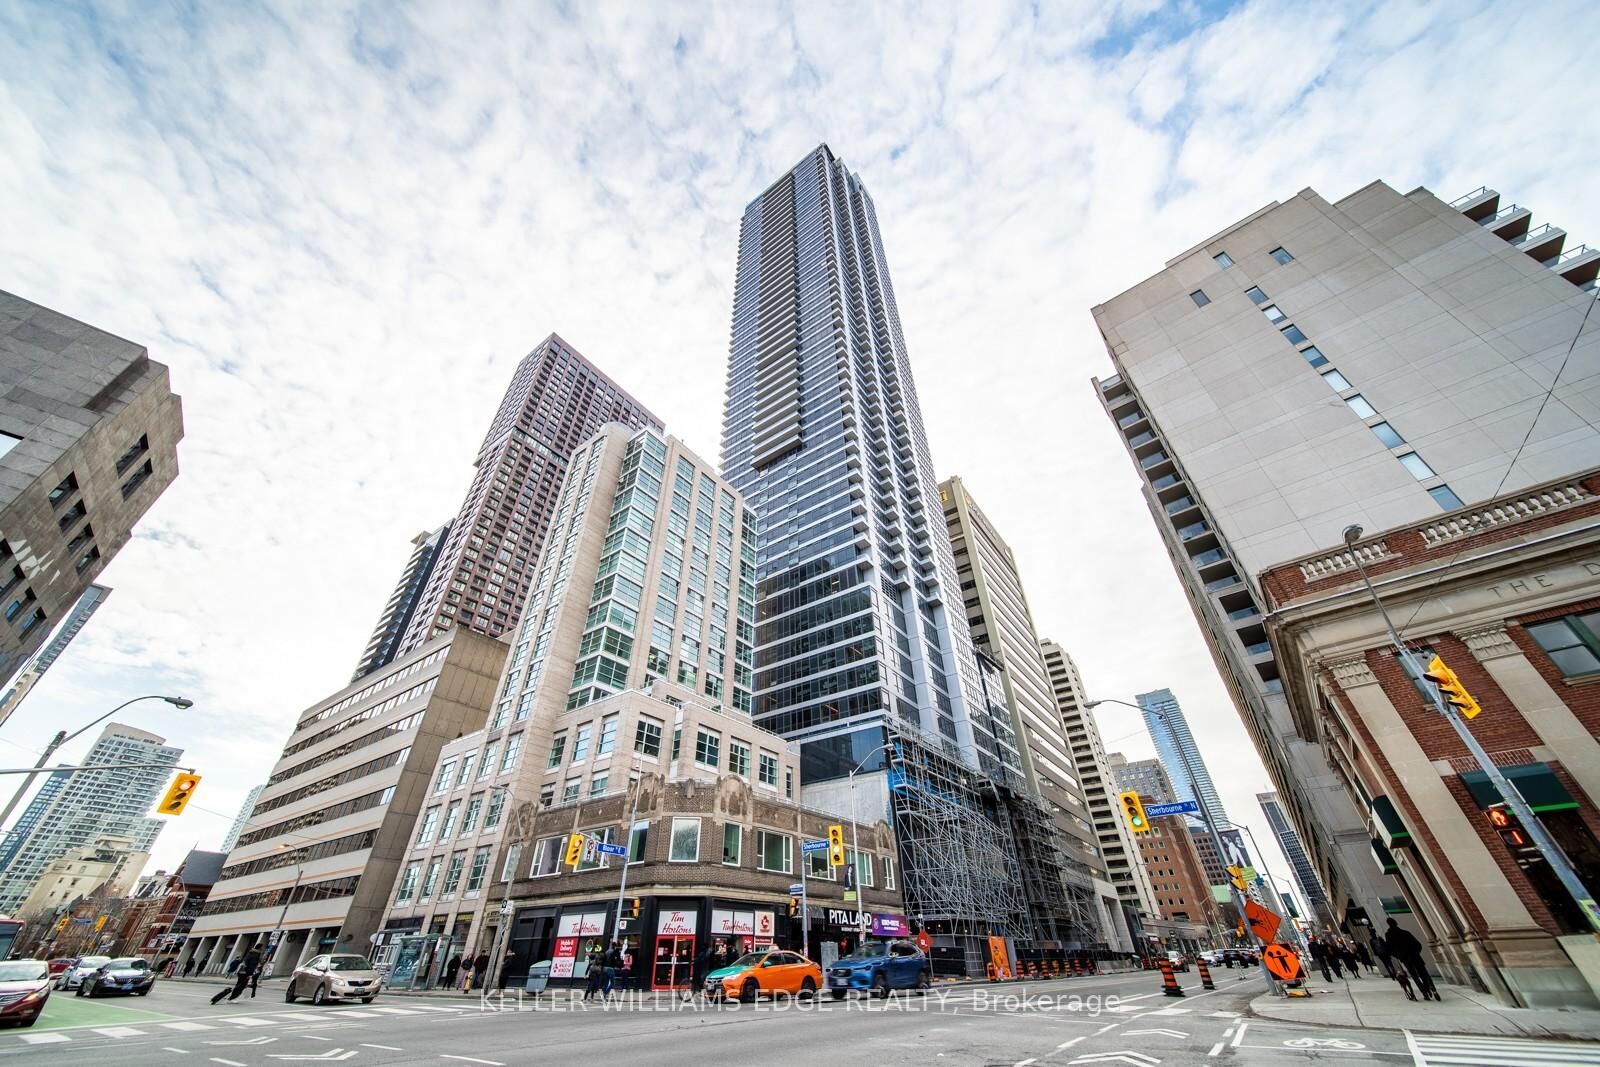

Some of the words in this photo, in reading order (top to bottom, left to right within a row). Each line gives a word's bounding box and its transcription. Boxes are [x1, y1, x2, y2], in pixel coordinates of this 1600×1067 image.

[1487, 574, 1554, 599] THE
[1147, 805, 1183, 815] Sherbourne
[803, 842, 827, 850] Sherbourne
[672, 911, 684, 922] Tim
[829, 909, 848, 925] PITA
[662, 923, 692, 934] Hortons
[722, 919, 733, 932] Tim
[733, 920, 753, 933] Hortons
